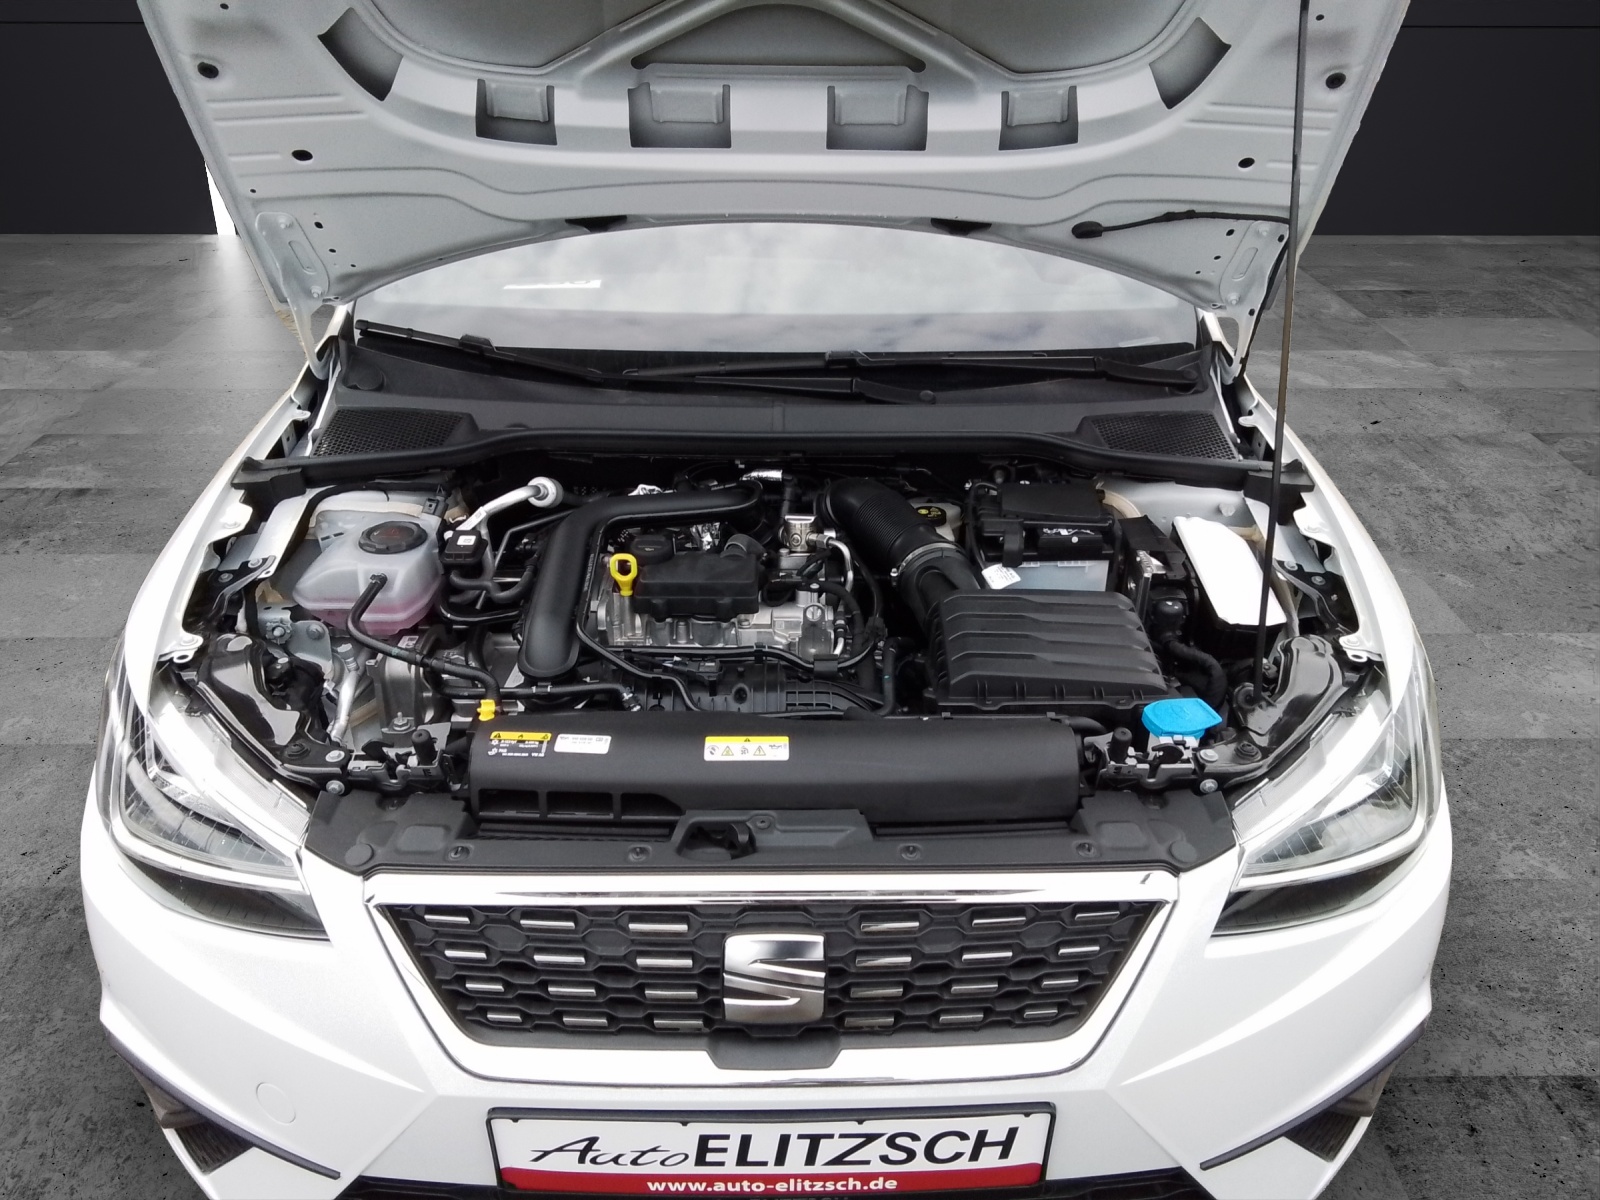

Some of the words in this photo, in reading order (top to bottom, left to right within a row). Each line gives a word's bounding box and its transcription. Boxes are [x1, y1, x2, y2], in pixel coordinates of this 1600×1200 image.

[529, 1135, 690, 1167] Auto
[693, 1126, 1020, 1168] ELITZSCH
[646, 1177, 898, 1193] www.auto-elitzsch.de
